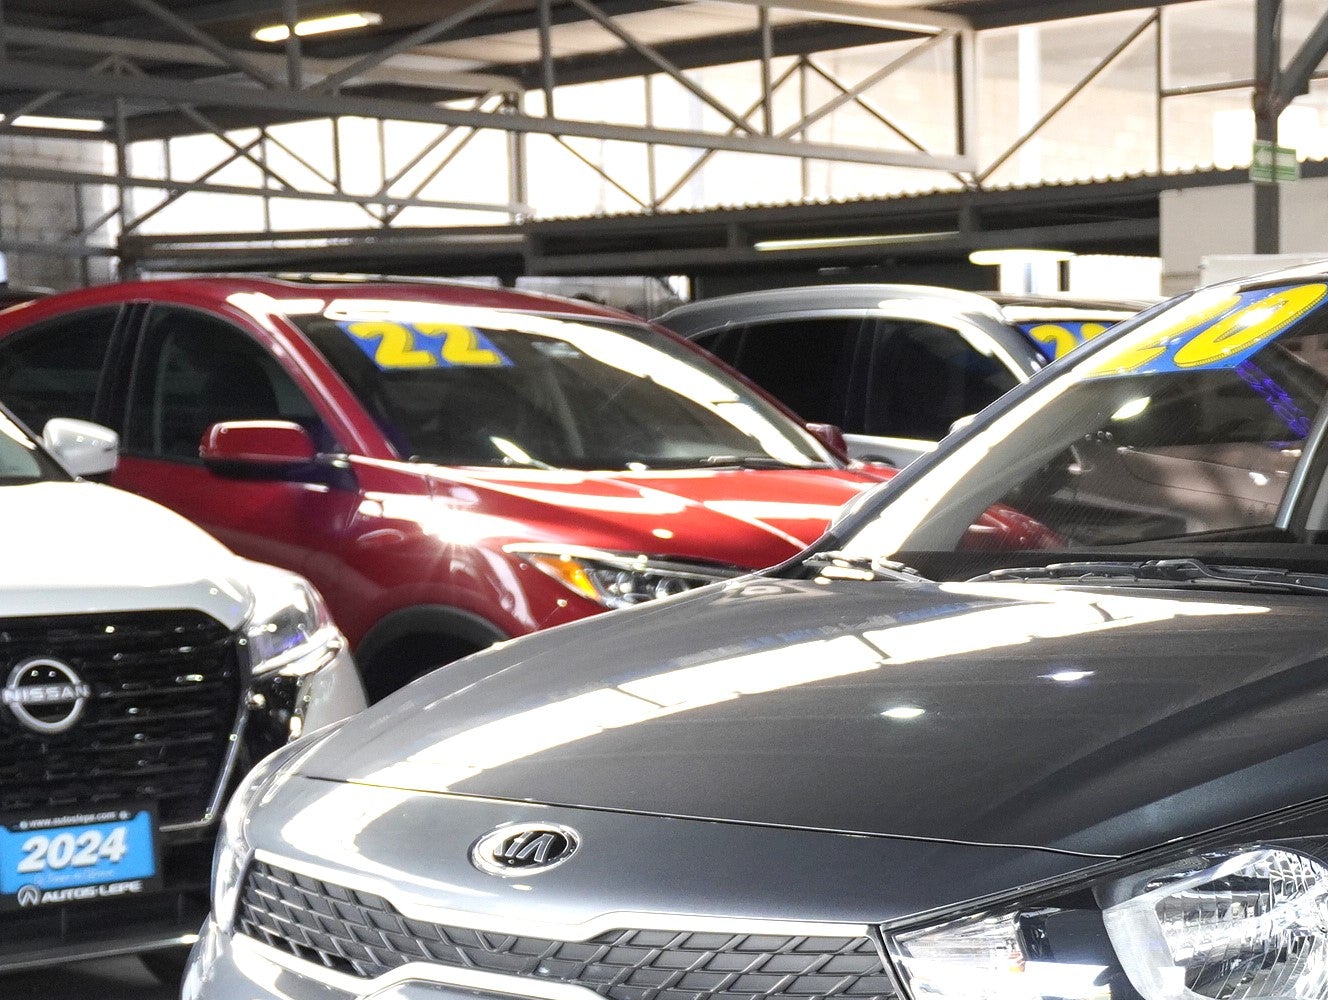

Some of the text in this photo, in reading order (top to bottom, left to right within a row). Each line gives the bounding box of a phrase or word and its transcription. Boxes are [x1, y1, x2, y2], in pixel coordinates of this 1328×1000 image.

[348, 322, 502, 367] 22
[2, 685, 91, 703] NISSAN
[29, 810, 116, 829] www.autoslepe.com
[17, 826, 127, 873] 2024
